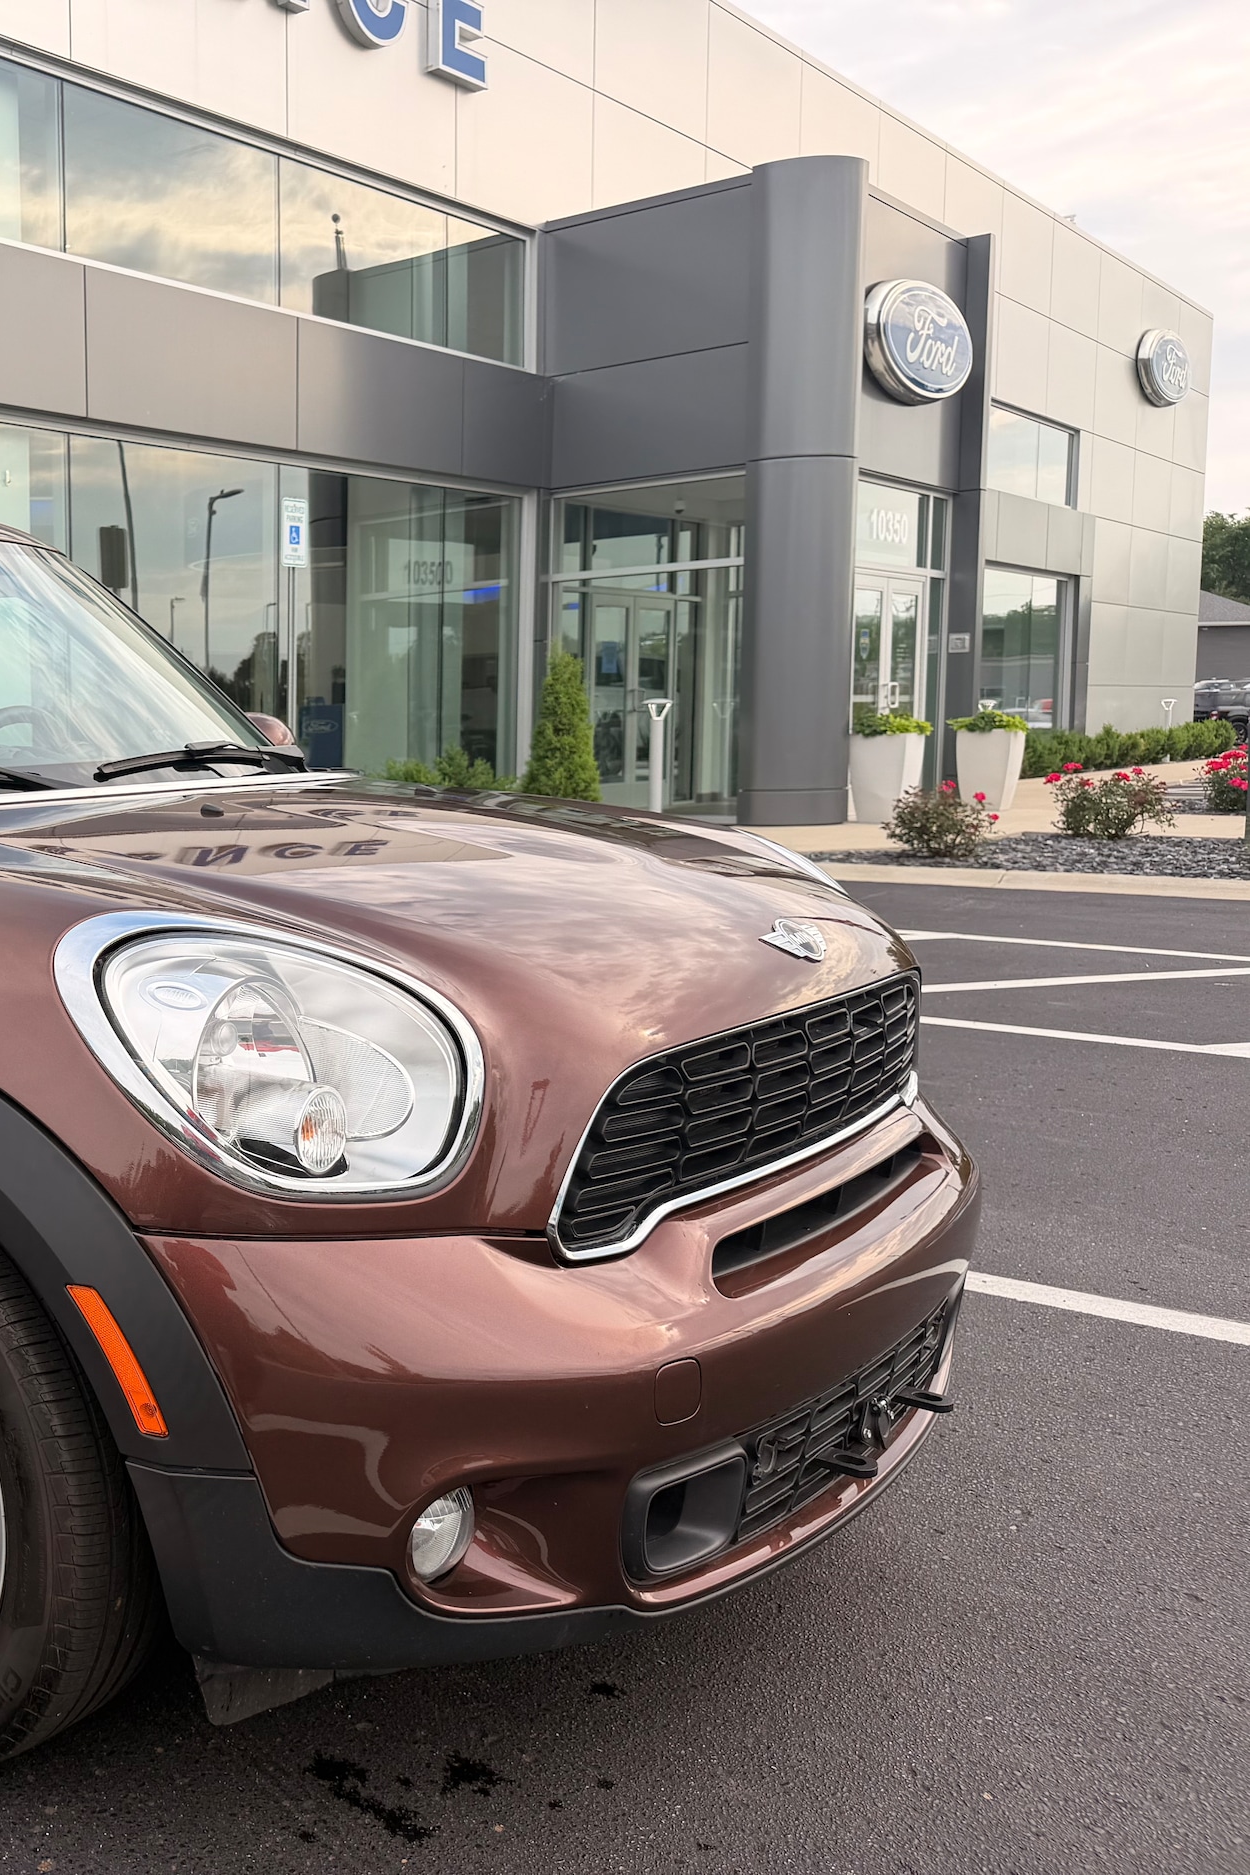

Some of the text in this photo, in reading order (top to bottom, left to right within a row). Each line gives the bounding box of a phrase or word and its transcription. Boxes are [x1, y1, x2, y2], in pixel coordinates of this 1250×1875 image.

[905, 305, 959, 376] Ford
[1161, 342, 1190, 390] Ford
[869, 507, 909, 545] 10350
